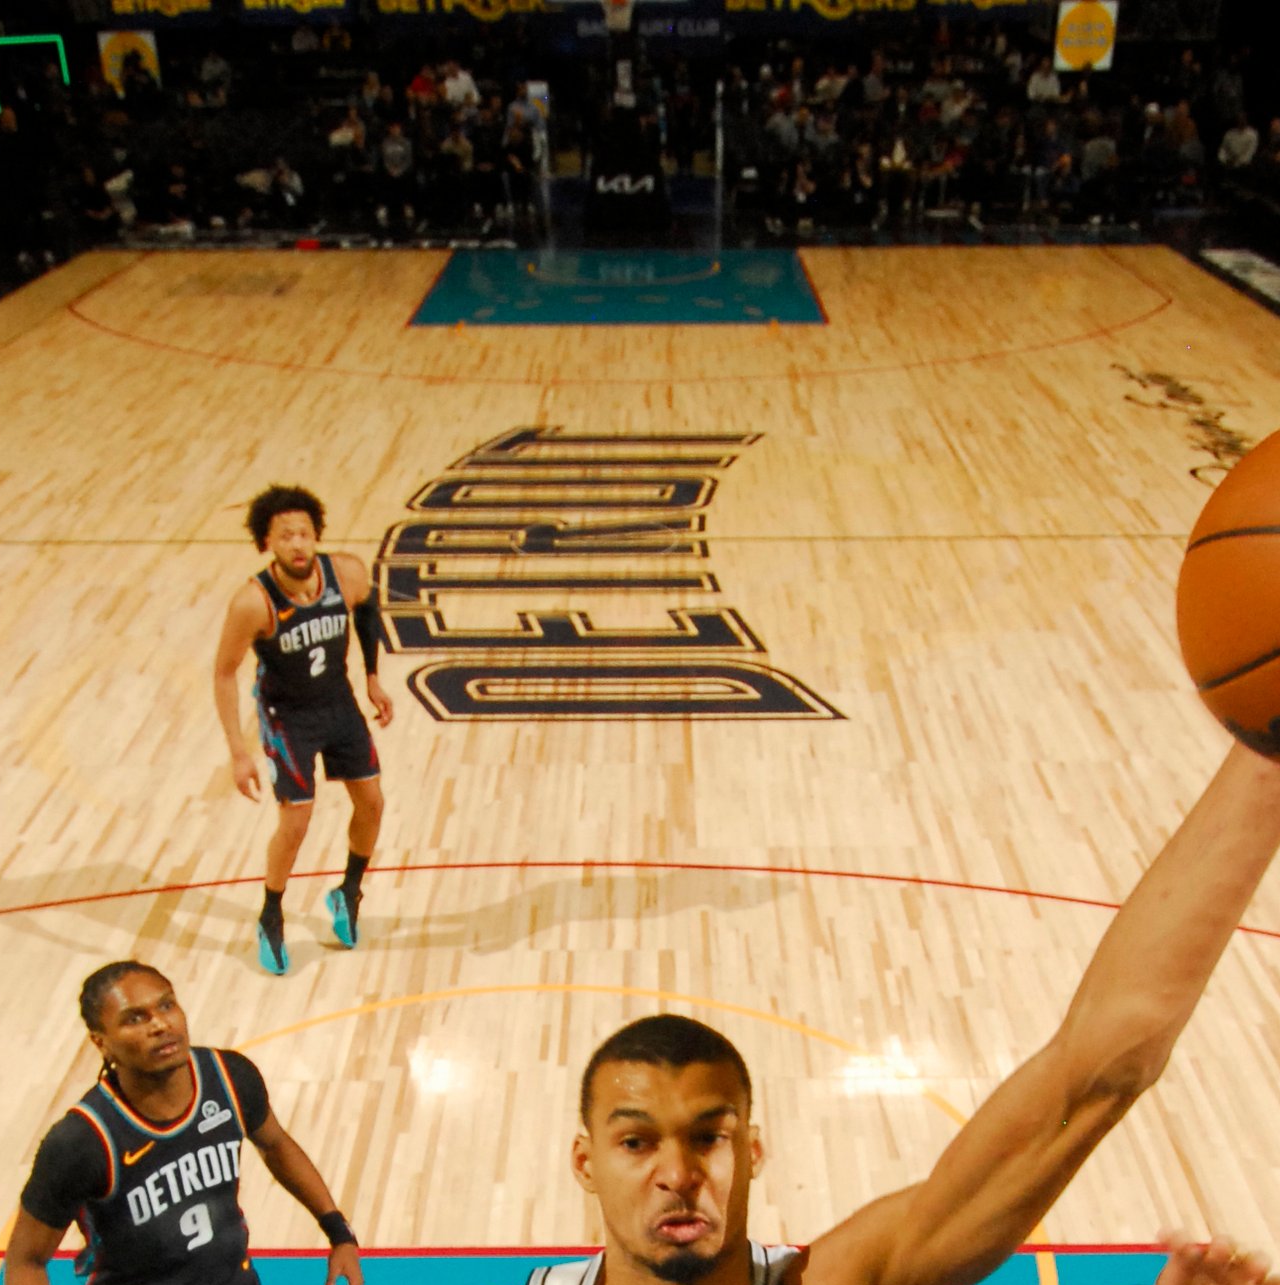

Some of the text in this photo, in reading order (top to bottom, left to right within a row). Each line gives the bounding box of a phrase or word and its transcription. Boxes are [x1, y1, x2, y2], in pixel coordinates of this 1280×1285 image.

[279, 614, 347, 654] DETROIT
[308, 646, 326, 678] 2
[126, 1140, 241, 1227] DETROIT
[179, 1202, 214, 1252] 9
